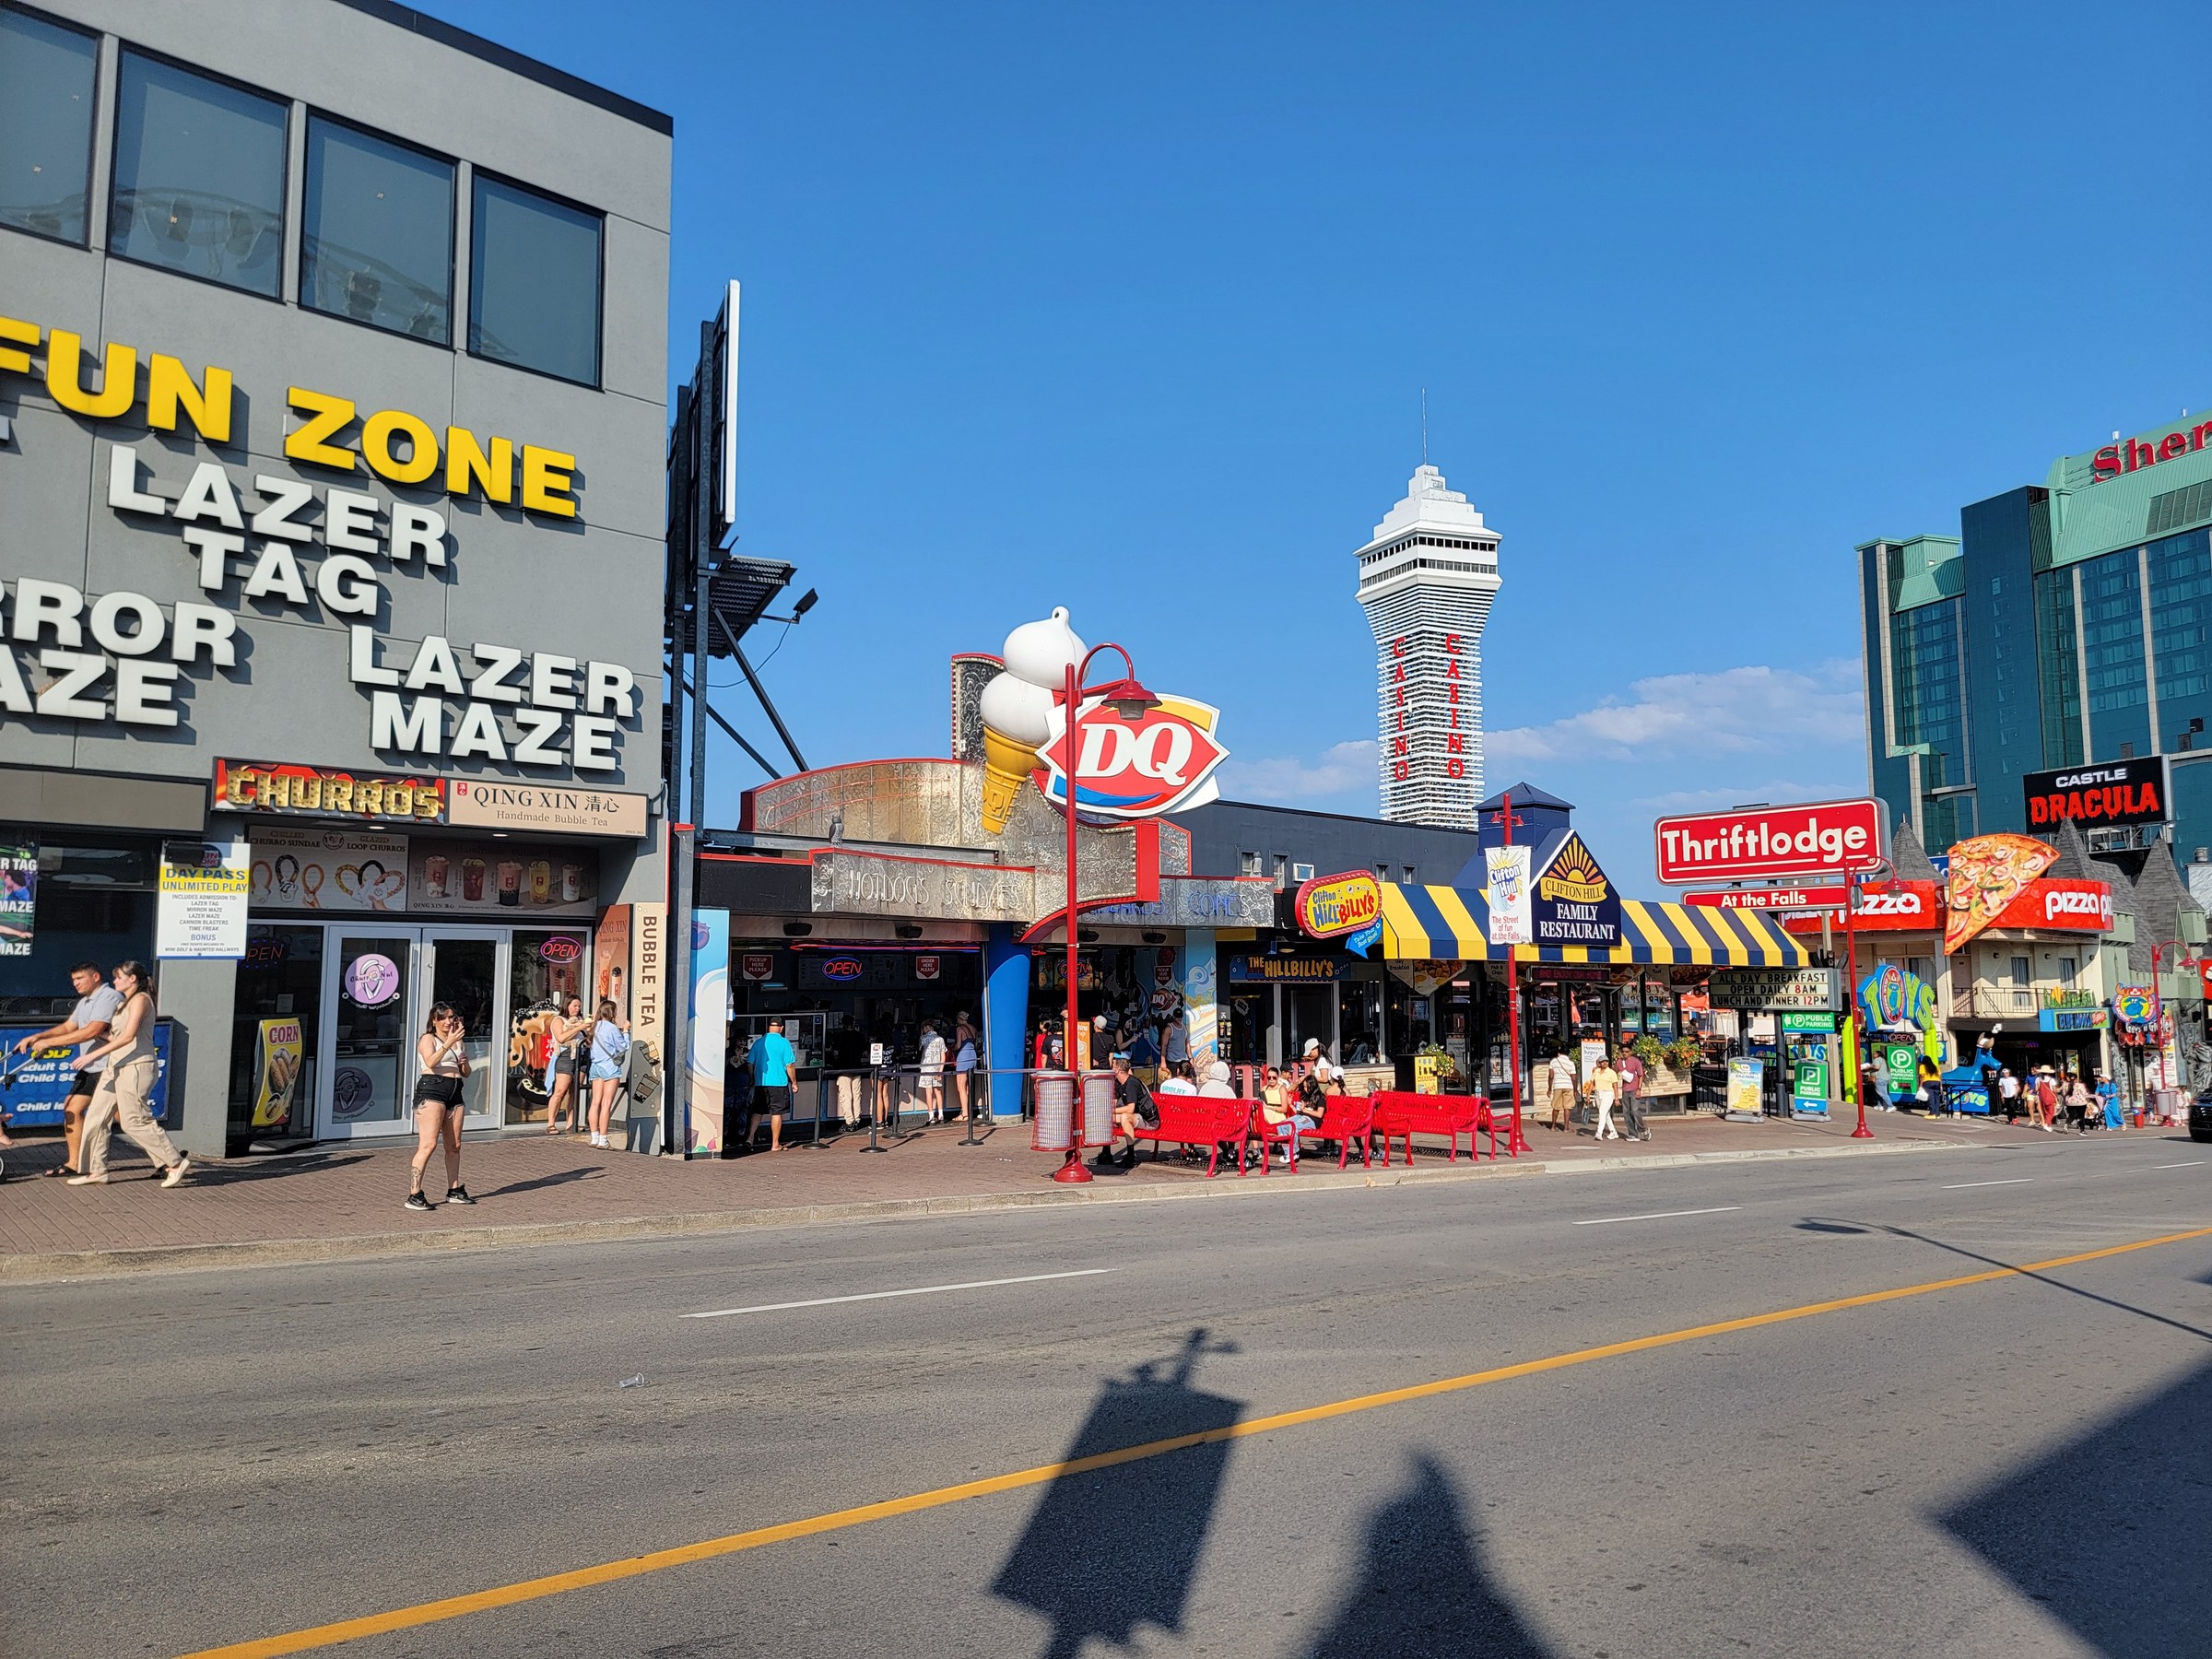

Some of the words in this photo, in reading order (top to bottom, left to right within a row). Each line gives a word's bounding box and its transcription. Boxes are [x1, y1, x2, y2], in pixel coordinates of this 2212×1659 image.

[284, 387, 577, 518] ZONE
[107, 444, 447, 567] LAZER
[183, 526, 378, 616] TAG
[0, 577, 237, 666] ROR
[349, 625, 635, 719] LAZER
[1392, 636, 1410, 782] CASINO
[1444, 633, 1465, 780] CASINO
[371, 691, 617, 771] MAZE
[1076, 723, 1193, 786] DQ
[2055, 768, 2127, 788] CASTLE
[227, 771, 441, 819] CHURROS
[474, 786, 533, 807] QING
[538, 792, 579, 810] XIN
[584, 795, 620, 813] 清心
[2030, 782, 2159, 825] DRACULA
[497, 810, 550, 822] Handmade
[555, 815, 587, 825] Bubble
[592, 818, 608, 826] Tea
[288, 840, 320, 848] SUNDAE
[369, 844, 406, 853] CHURROS
[1662, 818, 1867, 863] Thriftlodge
[12, 858, 37, 871] TAG
[166, 868, 198, 878] DAY
[203, 869, 245, 880] PASS
[1489, 865, 1521, 885] Clifton
[162, 882, 219, 891] UNLIMITED
[222, 883, 248, 891] PLAY
[1499, 878, 1518, 898] Hill
[1546, 880, 1582, 898] CLIFTON
[1583, 888, 1602, 900] HILL
[1189, 892, 1252, 917] CONES
[1312, 890, 1336, 904] Clifton
[1721, 895, 1742, 908] At
[1744, 894, 1766, 907] the
[1771, 891, 1806, 906] Falls
[2045, 891, 2100, 921] pizza
[1492, 916, 1502, 924] The
[1557, 903, 1598, 921] FAMILY
[598, 921, 613, 936] QING
[616, 920, 627, 933] XIN
[1539, 922, 1615, 940] RESTAURANT
[0, 943, 30, 956] AZE
[247, 947, 284, 961] PEN
[542, 943, 578, 958] OPEN
[641, 916, 657, 984] BUBBLE
[824, 961, 863, 975] OPEN
[1248, 957, 1265, 968] THE
[1265, 959, 1334, 977] HILLBILLY'S
[1719, 974, 1736, 983] ALL
[1740, 974, 1761, 982] DAY
[1768, 972, 1826, 982] BREAKFAST
[1730, 985, 1755, 994] OPEN
[1760, 984, 1790, 994] DAILY
[1794, 984, 1818, 994] 8AM
[1152, 994, 1165, 1005] DQ
[1711, 996, 1741, 1006] LUNCH
[1744, 996, 1762, 1006] AND
[1765, 996, 1799, 1006] DINNER
[1803, 995, 1829, 1006] 12PM
[1864, 967, 1936, 1031] TOYS
[641, 993, 655, 1027] TEA
[1795, 1017, 1803, 1025] P
[269, 1025, 299, 1044] CORN
[1891, 1033, 1914, 1041] OPEN
[1897, 1053, 1907, 1065] P
[18, 1073, 55, 1083] Child
[1806, 1070, 1816, 1081] P
[17, 1102, 52, 1112] Child
